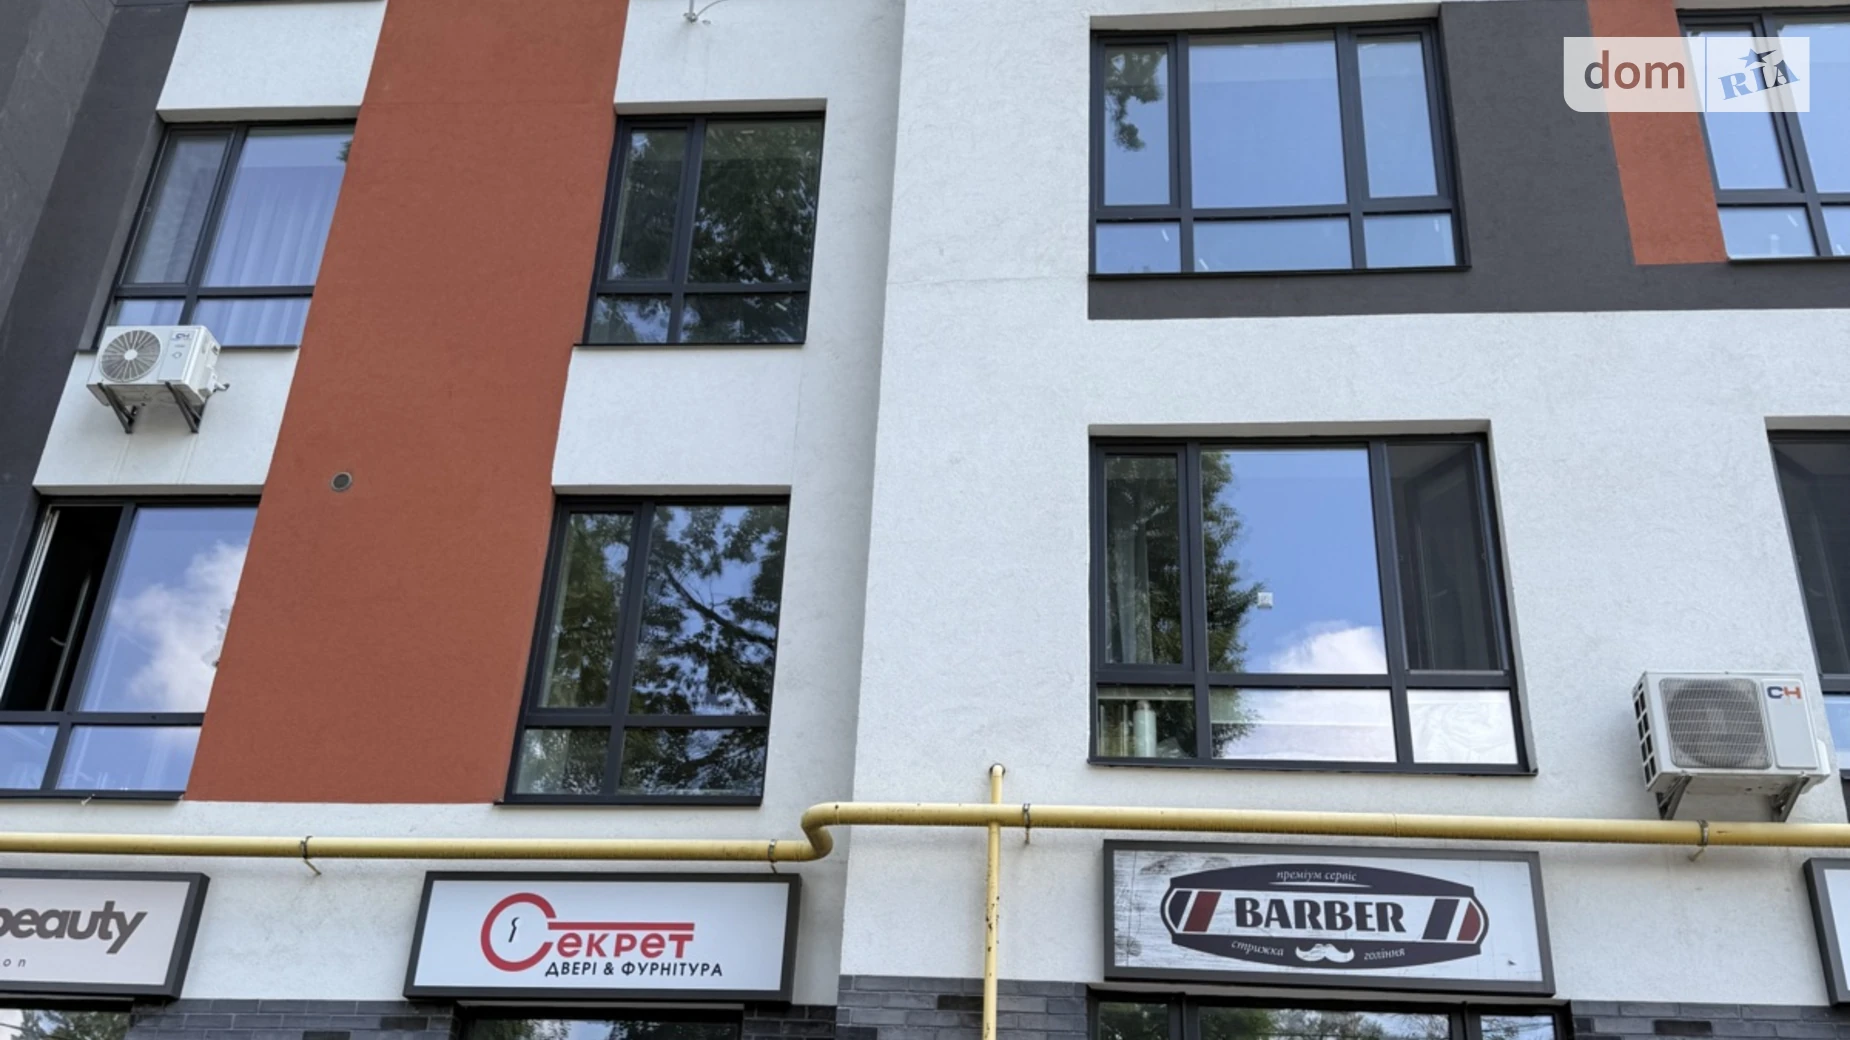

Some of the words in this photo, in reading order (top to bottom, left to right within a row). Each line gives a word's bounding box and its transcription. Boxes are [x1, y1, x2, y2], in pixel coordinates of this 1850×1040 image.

[1767, 686, 1801, 699] CH
[1276, 869, 1322, 883] преміум
[1324, 871, 1357, 883] сервіс
[1234, 897, 1406, 932] BARBER
[1231, 941, 1284, 956] стрижка
[1364, 947, 1405, 960] гоління
[545, 962, 597, 977] ДВЕРІ
[603, 962, 614, 976] &
[621, 961, 723, 977] ФУРНІТУРА
